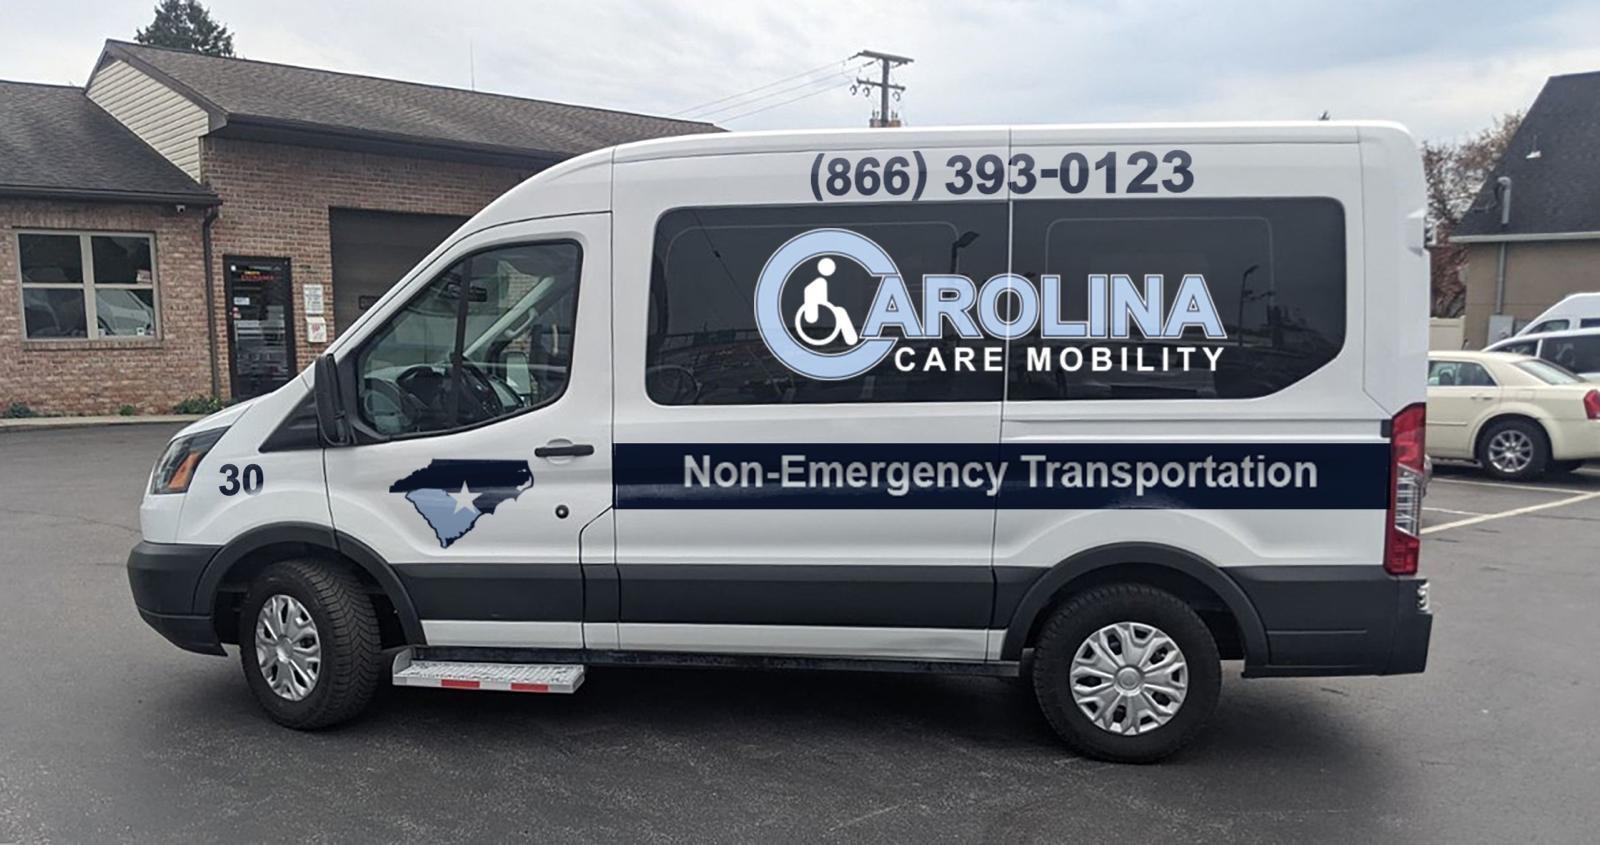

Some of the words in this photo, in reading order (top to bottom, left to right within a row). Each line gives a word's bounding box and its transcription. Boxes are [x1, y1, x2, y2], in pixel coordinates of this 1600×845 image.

[810, 151, 928, 201] (866)
[945, 150, 1195, 196] 393-0123
[754, 227, 1228, 381] CAROLINA
[894, 346, 1004, 372] CARE
[1027, 346, 1226, 372] MOBILITY
[219, 463, 264, 496] 30
[683, 454, 1009, 497] Non-Emergency
[1021, 454, 1318, 496] Transportation
